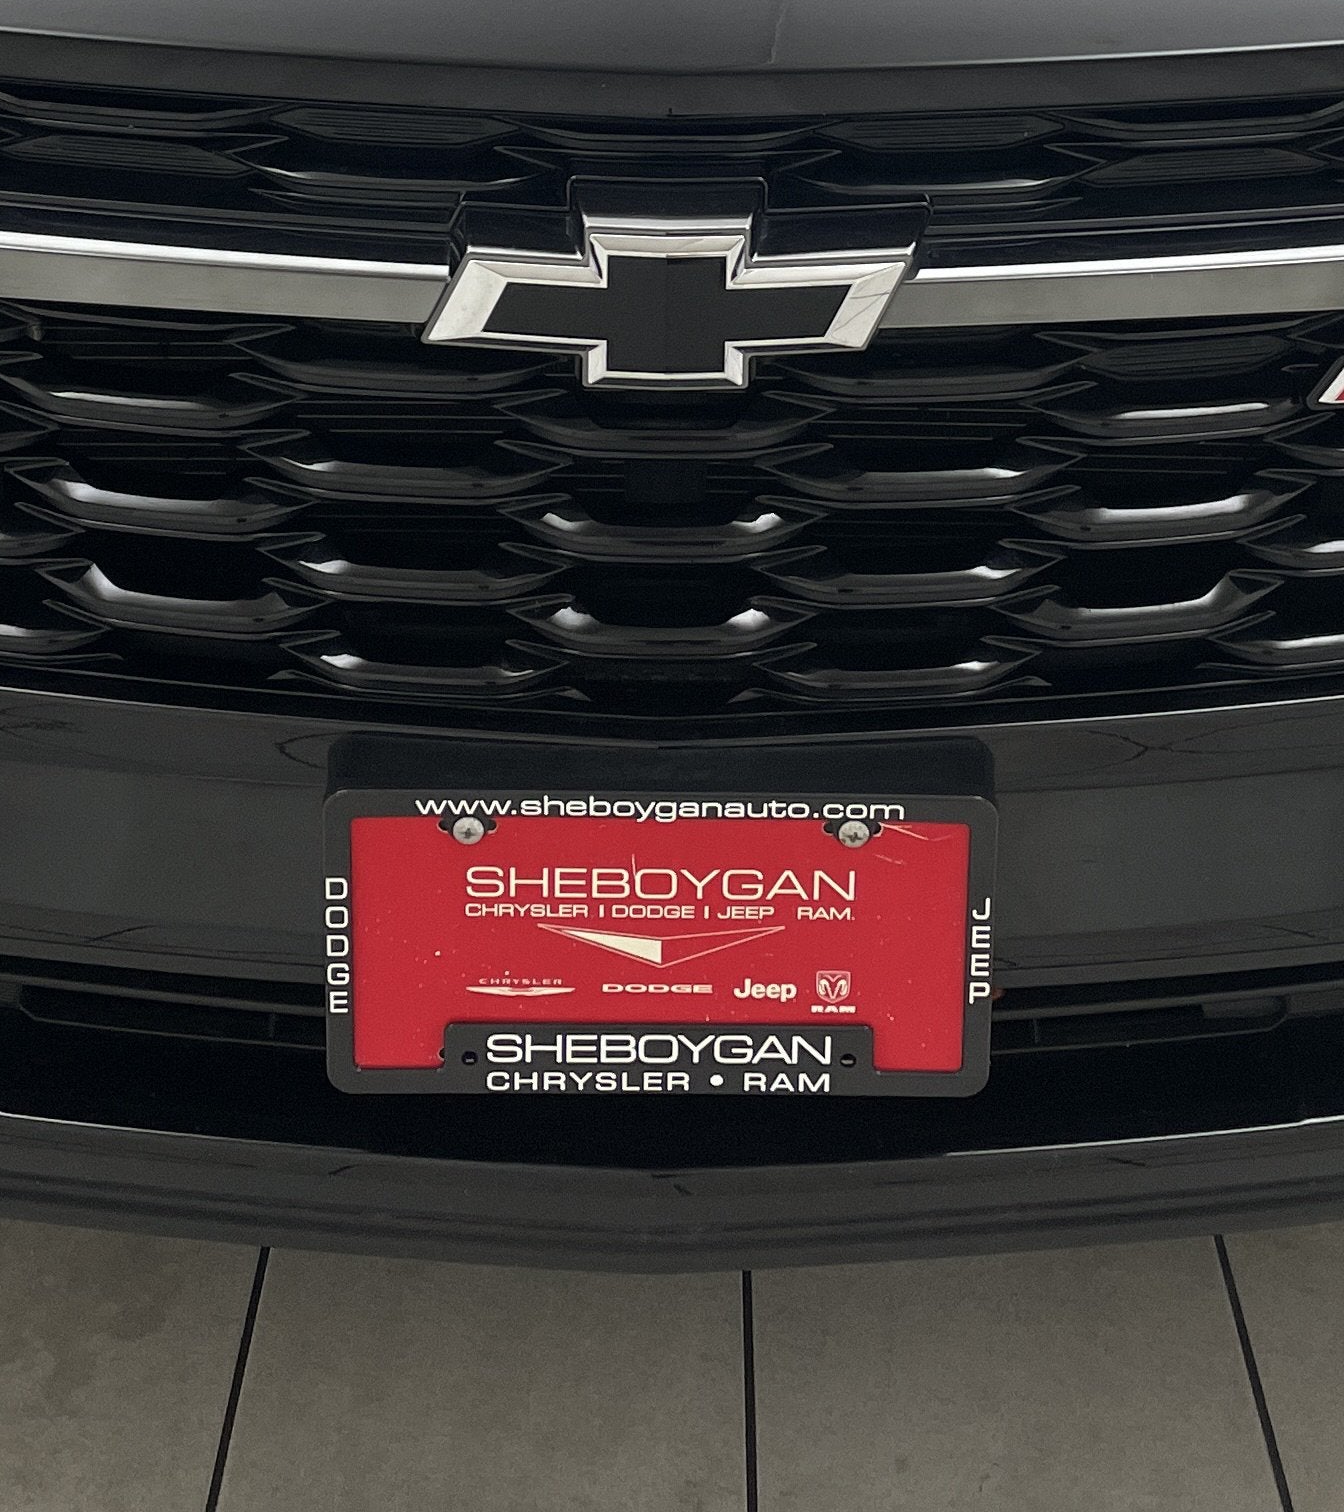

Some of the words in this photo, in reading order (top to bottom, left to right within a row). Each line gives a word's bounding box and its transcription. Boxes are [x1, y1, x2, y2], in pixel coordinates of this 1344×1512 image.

[415, 794, 905, 823] www.sheboyganauto.com
[465, 865, 856, 902] SHEBOYGAN
[464, 903, 588, 918] CHRYSLER
[611, 905, 695, 919] DODGE
[716, 905, 775, 920] JEEP
[325, 877, 350, 1014] DODGE
[968, 897, 991, 1005] JEEP
[478, 977, 563, 986] CHRYSLER
[601, 983, 713, 994] DODGE
[733, 978, 798, 1002] Jeep
[810, 1005, 857, 1014] RAM
[486, 1033, 833, 1065] SHEBOYGAN
[486, 1071, 690, 1092] CHRYSLER
[743, 1072, 831, 1093] RAM
